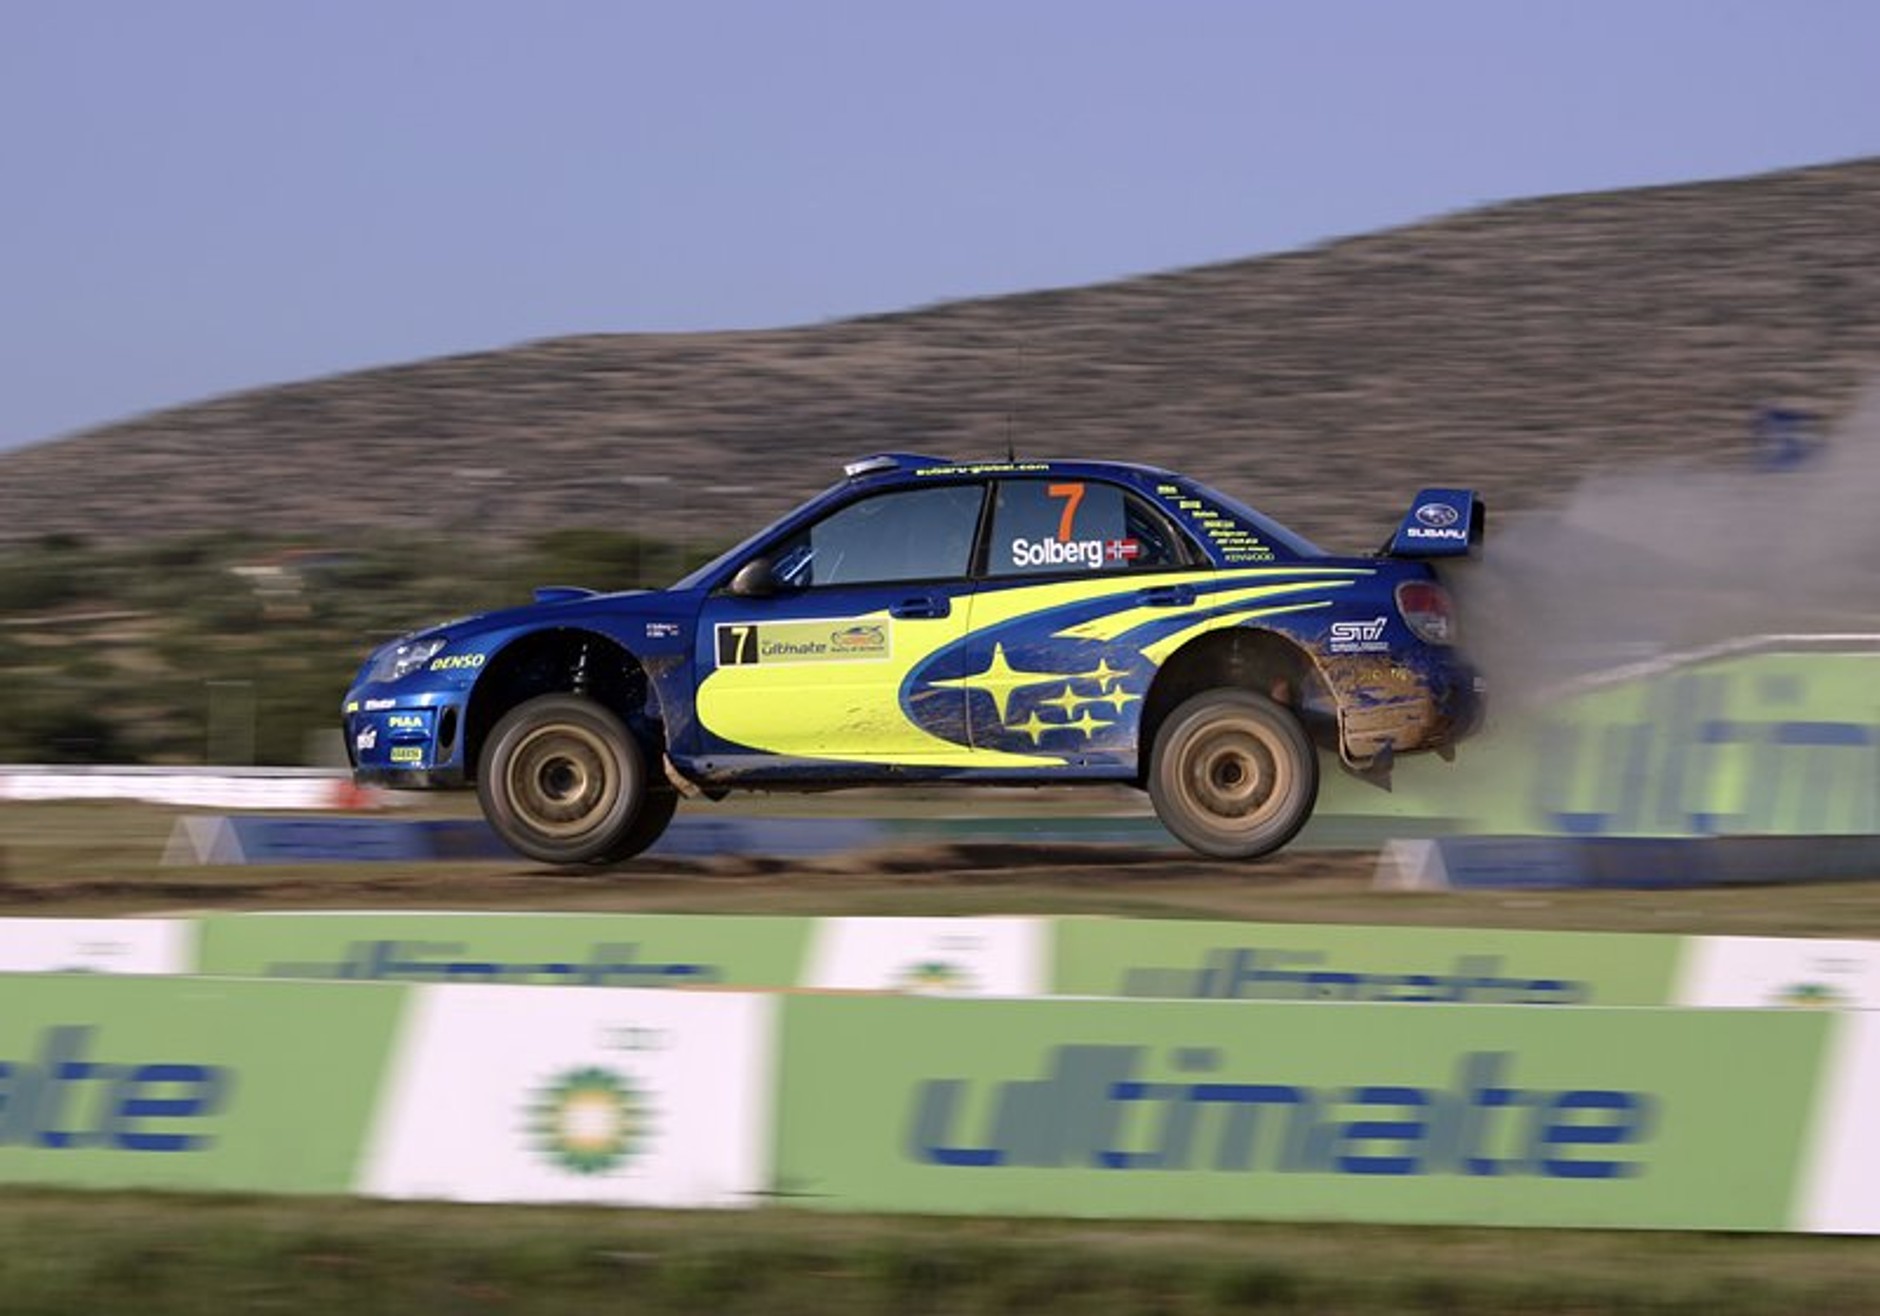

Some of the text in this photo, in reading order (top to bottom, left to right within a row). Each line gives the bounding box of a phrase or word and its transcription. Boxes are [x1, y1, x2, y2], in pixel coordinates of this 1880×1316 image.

[1048, 483, 1085, 541] 7
[1407, 528, 1466, 539] SUBARU
[1012, 537, 1102, 567] Solberg
[731, 627, 749, 664] 7
[761, 640, 827, 655] ultimate
[430, 653, 485, 671] DENSO
[389, 716, 423, 728] PIAA
[906, 1042, 1655, 1180] ultimate
